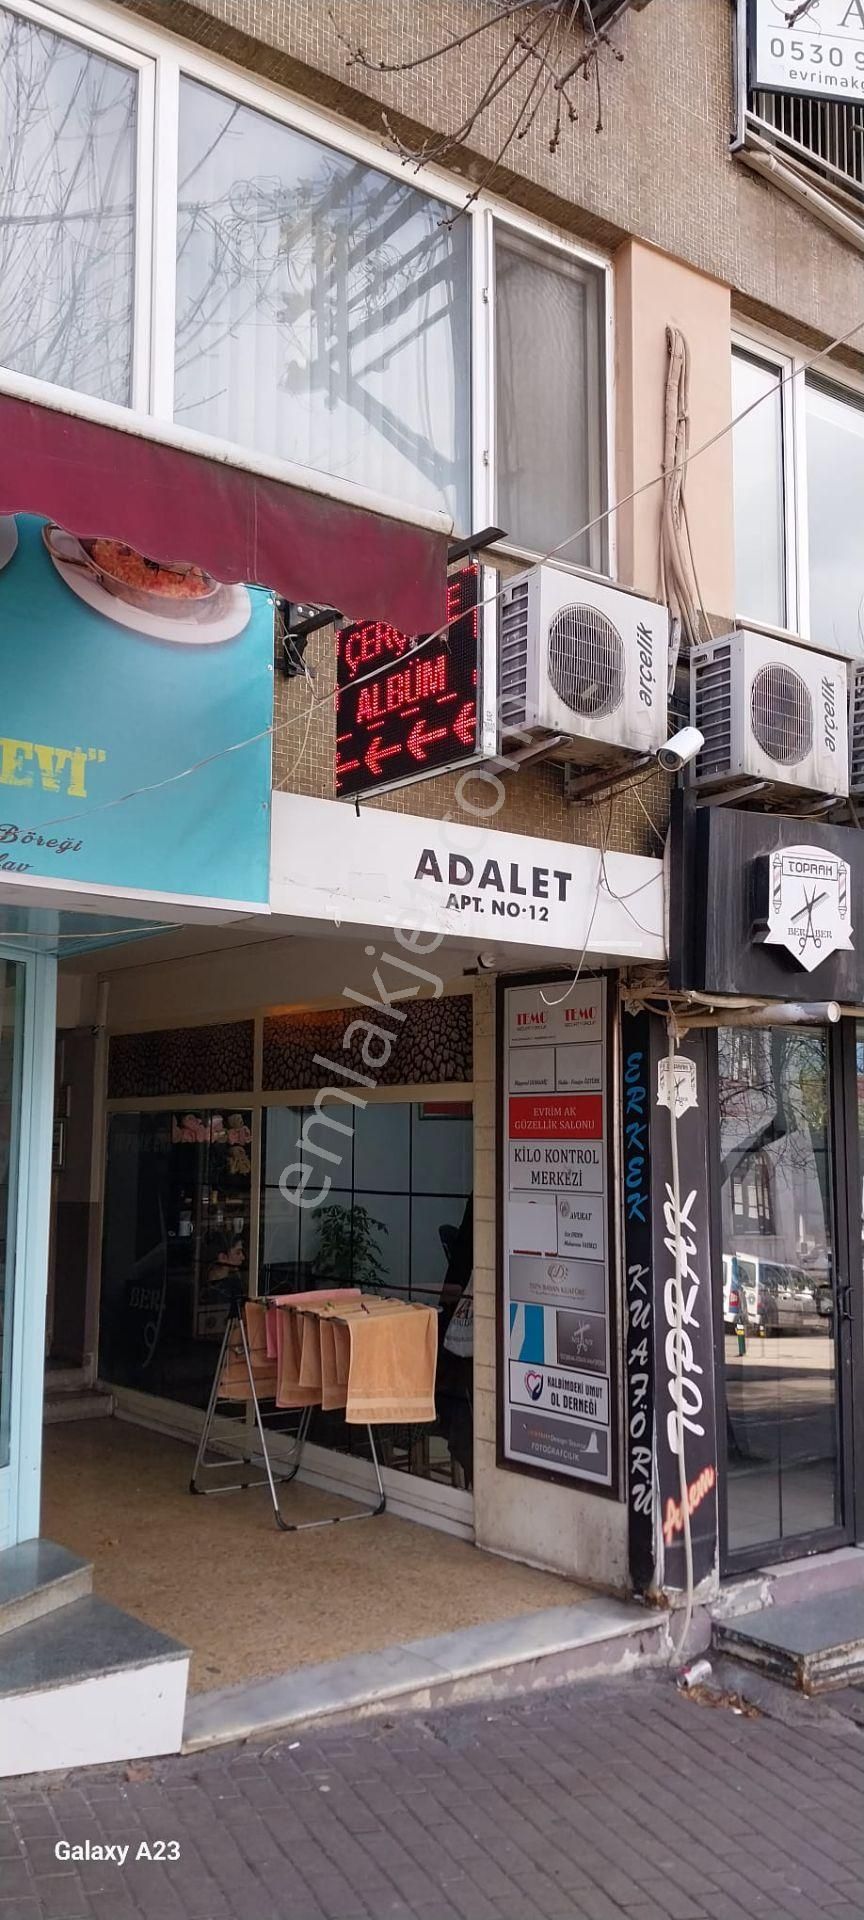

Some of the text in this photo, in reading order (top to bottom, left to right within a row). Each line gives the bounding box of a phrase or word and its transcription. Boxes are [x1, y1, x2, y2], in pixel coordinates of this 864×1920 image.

[770, 38, 843, 67] 0530
[636, 621, 654, 708] arçelik
[356, 654, 448, 723] ALBÜM
[822, 675, 836, 754] arçelik
[0, 823, 84, 854] Böreği
[414, 848, 572, 902] ADALET
[788, 860, 833, 876] TOPRAK
[445, 893, 484, 914] APT.
[565, 1007, 597, 1021] TEMO
[564, 1106, 577, 1116] AK
[514, 1119, 595, 1131] GÜZELLİK SALONU
[514, 1146, 600, 1164] KİLO KONTROL
[531, 1169, 582, 1187] MERKEZİ
[569, 1211, 593, 1222] AVUKAT
[624, 1052, 653, 1516] ERKEK KUAFÖRÜ
[547, 1375, 603, 1399] KALBİMDEKİ UMUT
[551, 1392, 597, 1416] OL DERNEĞİ
